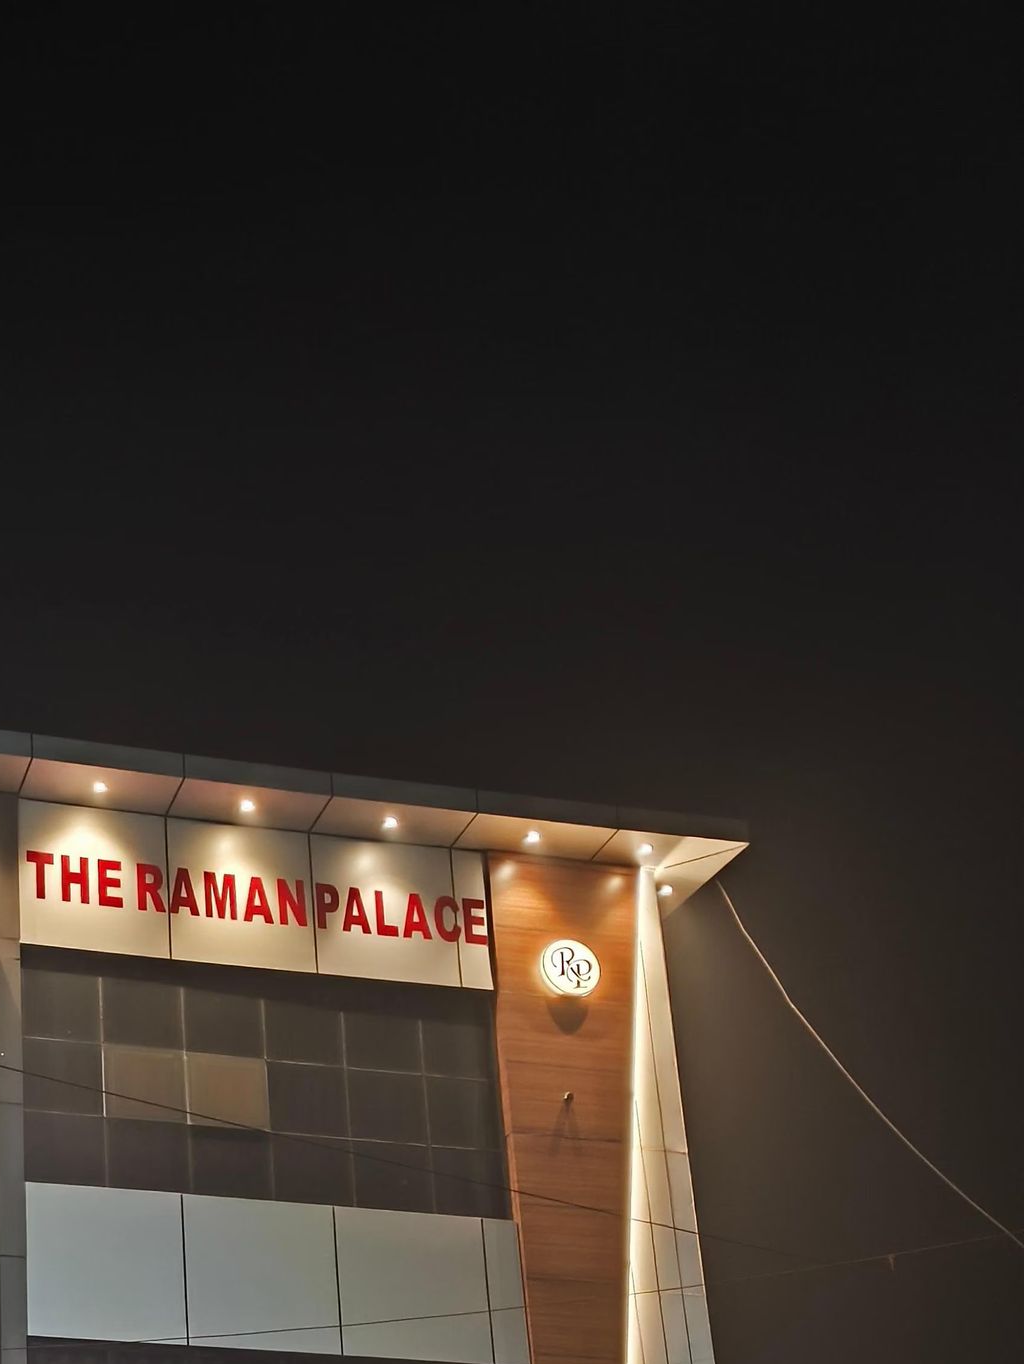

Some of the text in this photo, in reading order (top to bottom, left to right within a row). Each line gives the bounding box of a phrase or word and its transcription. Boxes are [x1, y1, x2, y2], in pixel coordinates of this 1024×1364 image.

[26, 850, 489, 946] THE RAMAN PALACE
